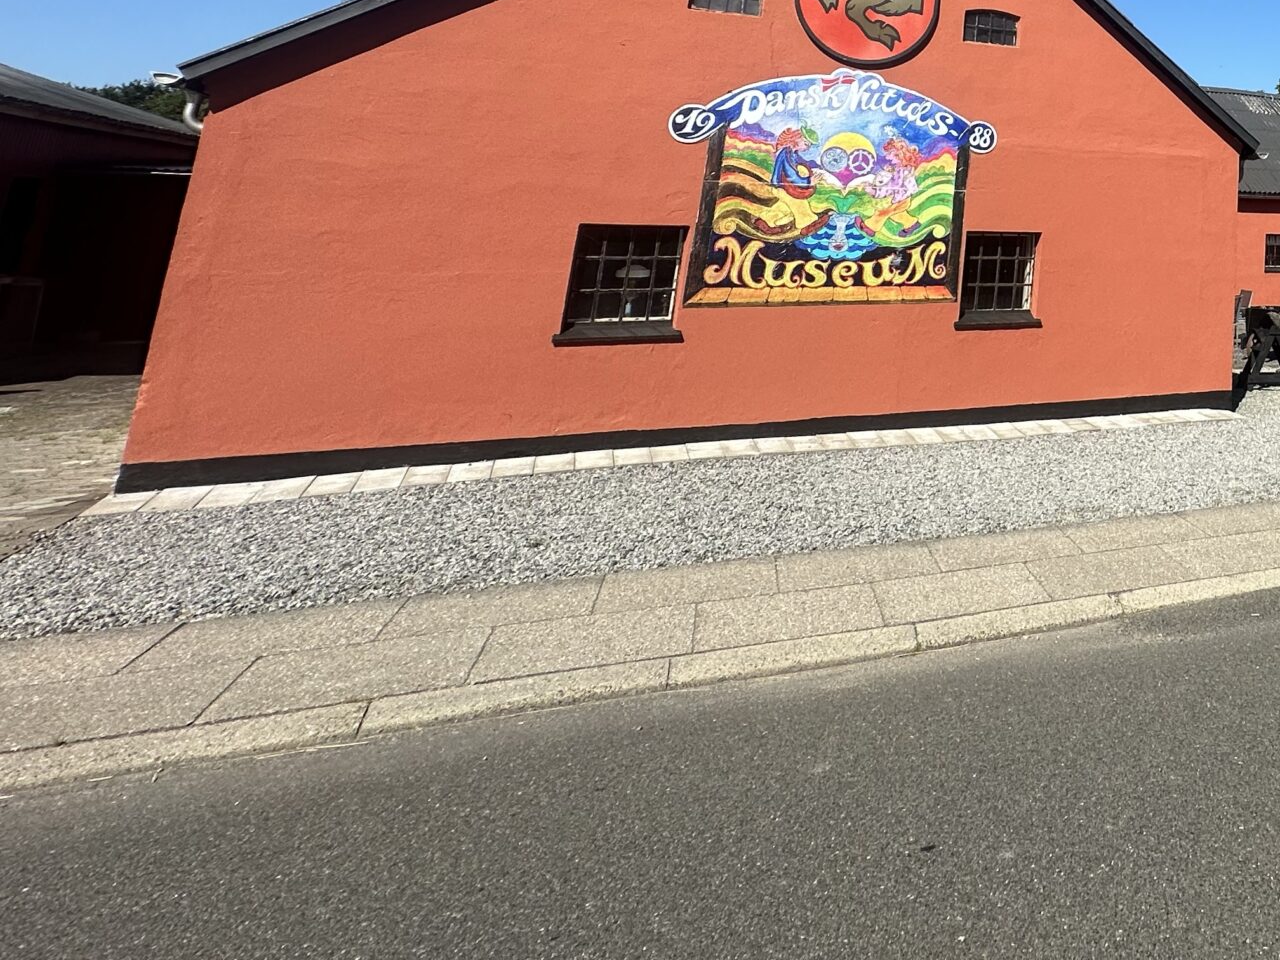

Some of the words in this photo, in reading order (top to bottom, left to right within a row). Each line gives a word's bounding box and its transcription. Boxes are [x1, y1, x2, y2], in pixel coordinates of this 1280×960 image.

[674, 110, 714, 130] 19
[720, 86, 843, 129] Dansk
[970, 126, 992, 148] 88
